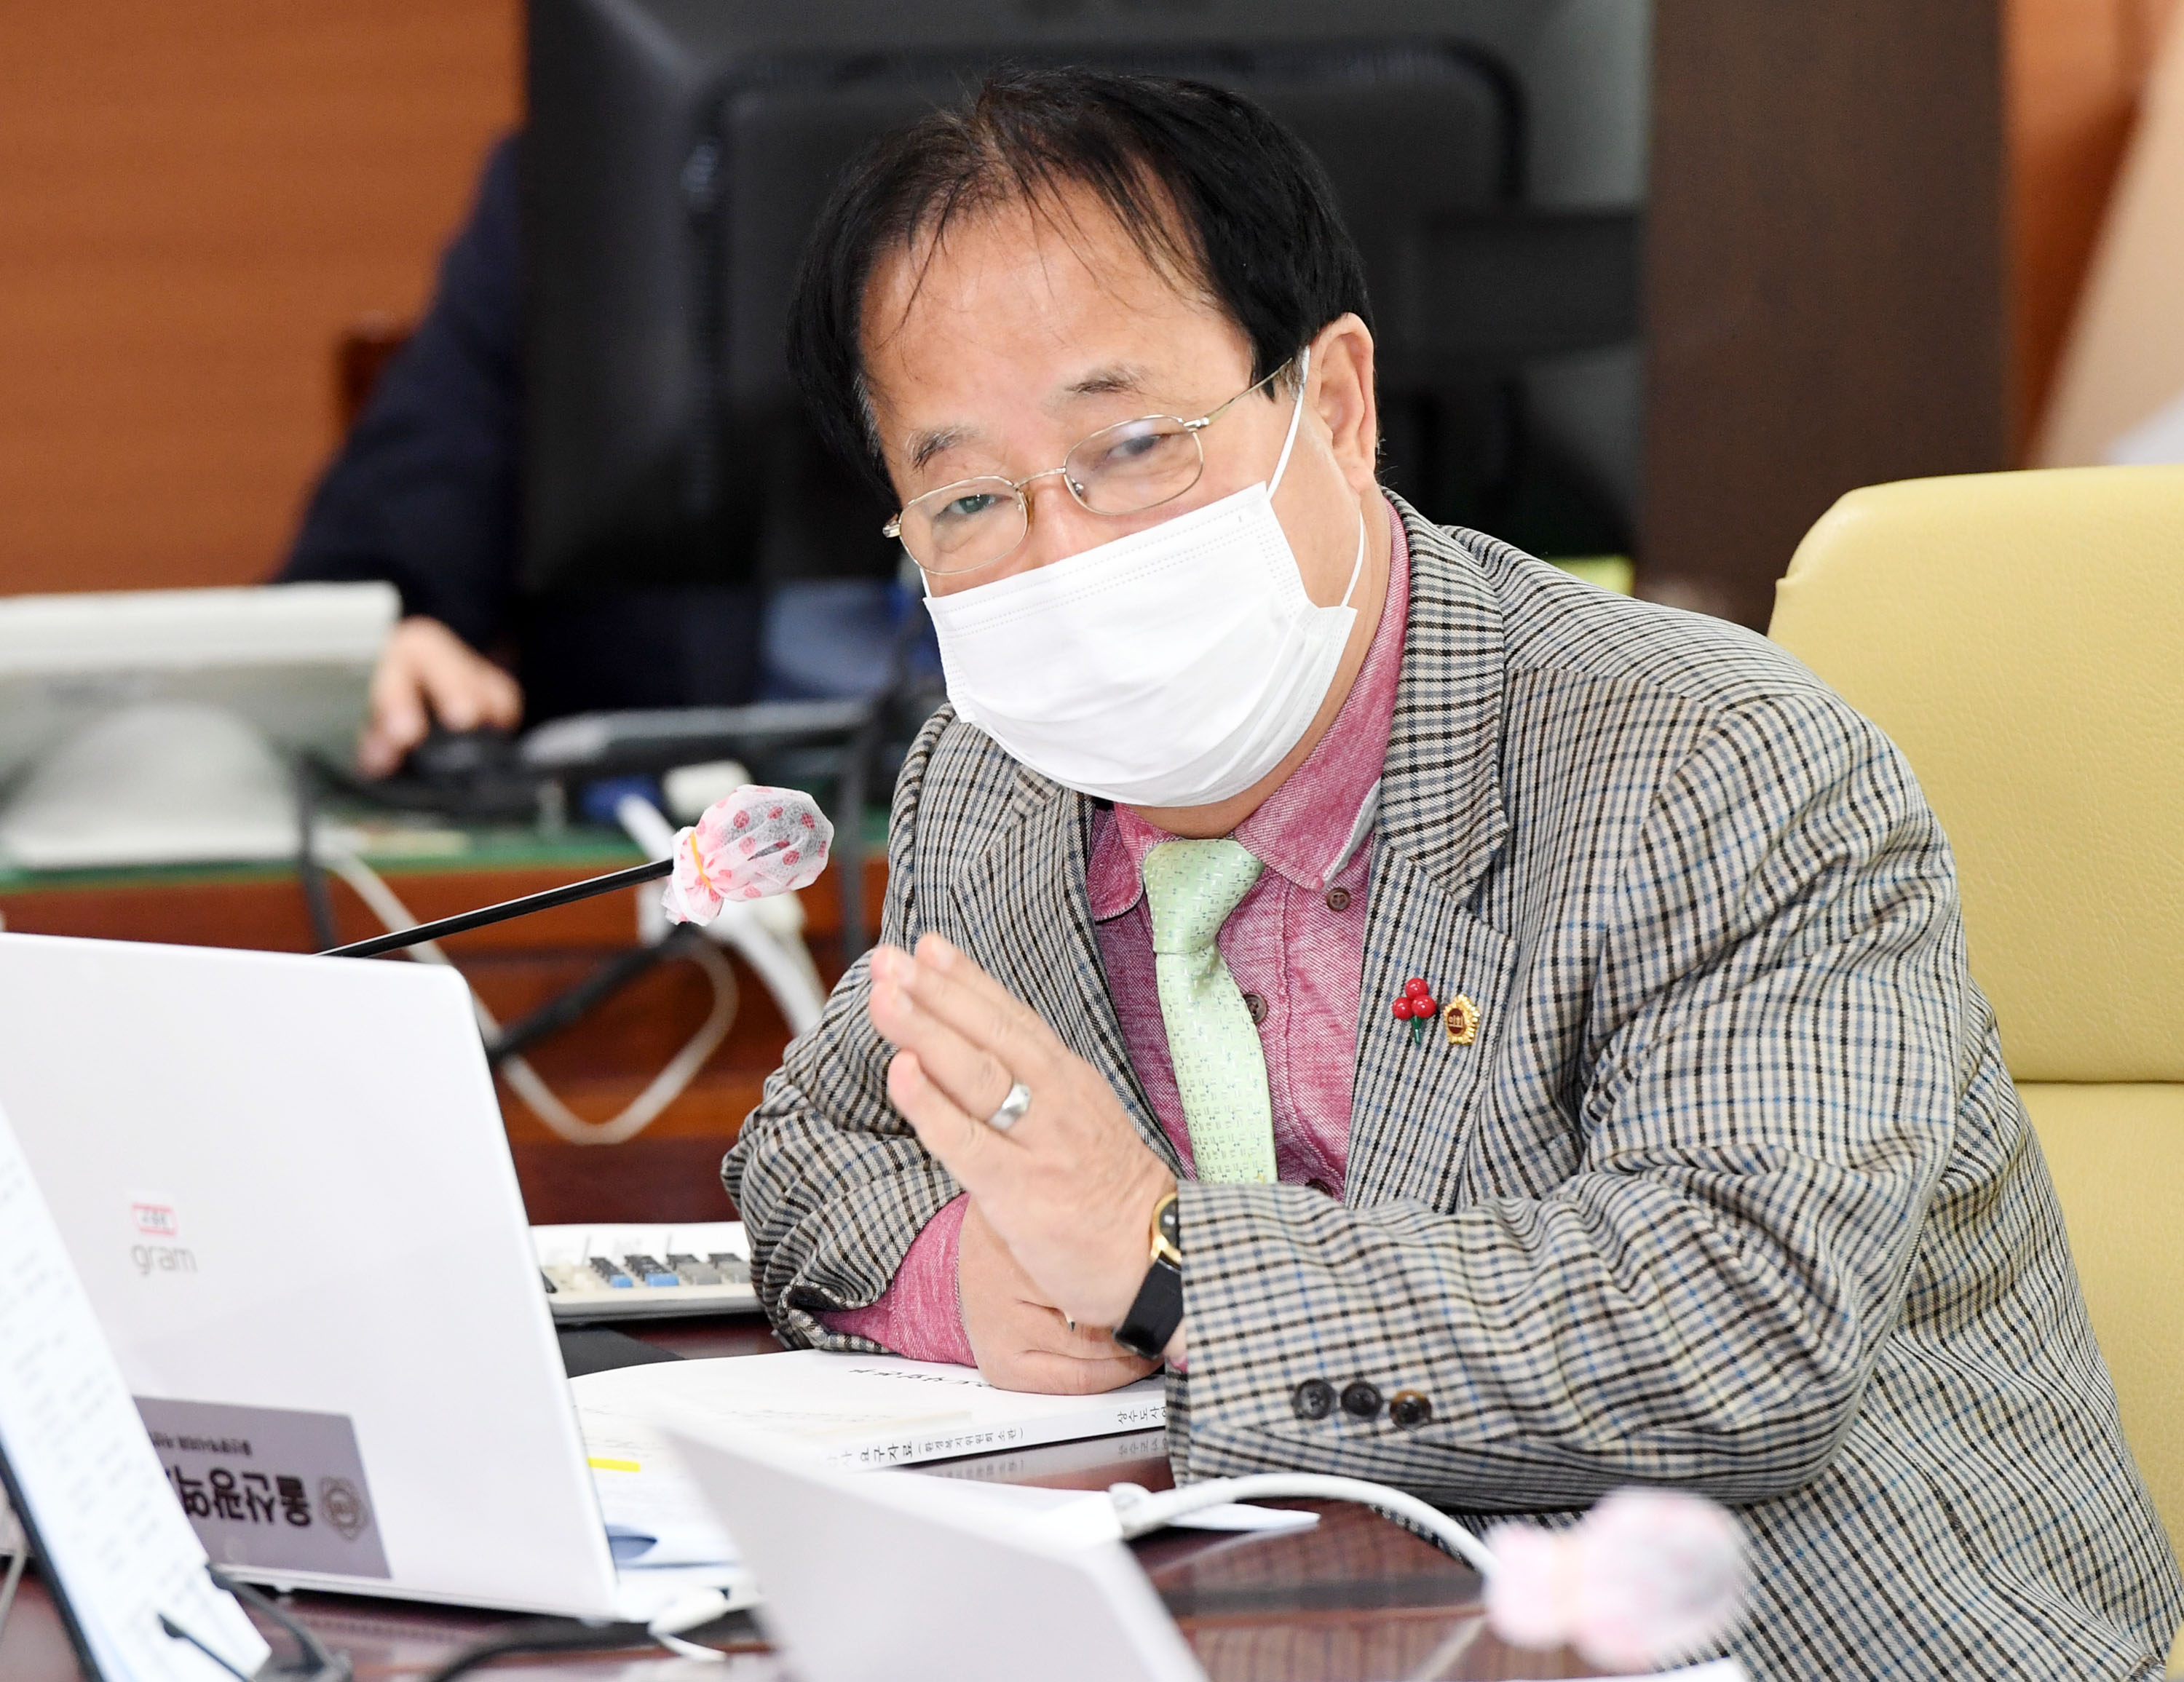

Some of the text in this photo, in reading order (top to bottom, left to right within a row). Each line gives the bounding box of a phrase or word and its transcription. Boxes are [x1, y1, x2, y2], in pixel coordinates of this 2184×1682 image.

[131, 1245, 197, 1277] gram
[859, 1440, 914, 1463] 요구자료
[165, 1465, 312, 1530] 울산광역
